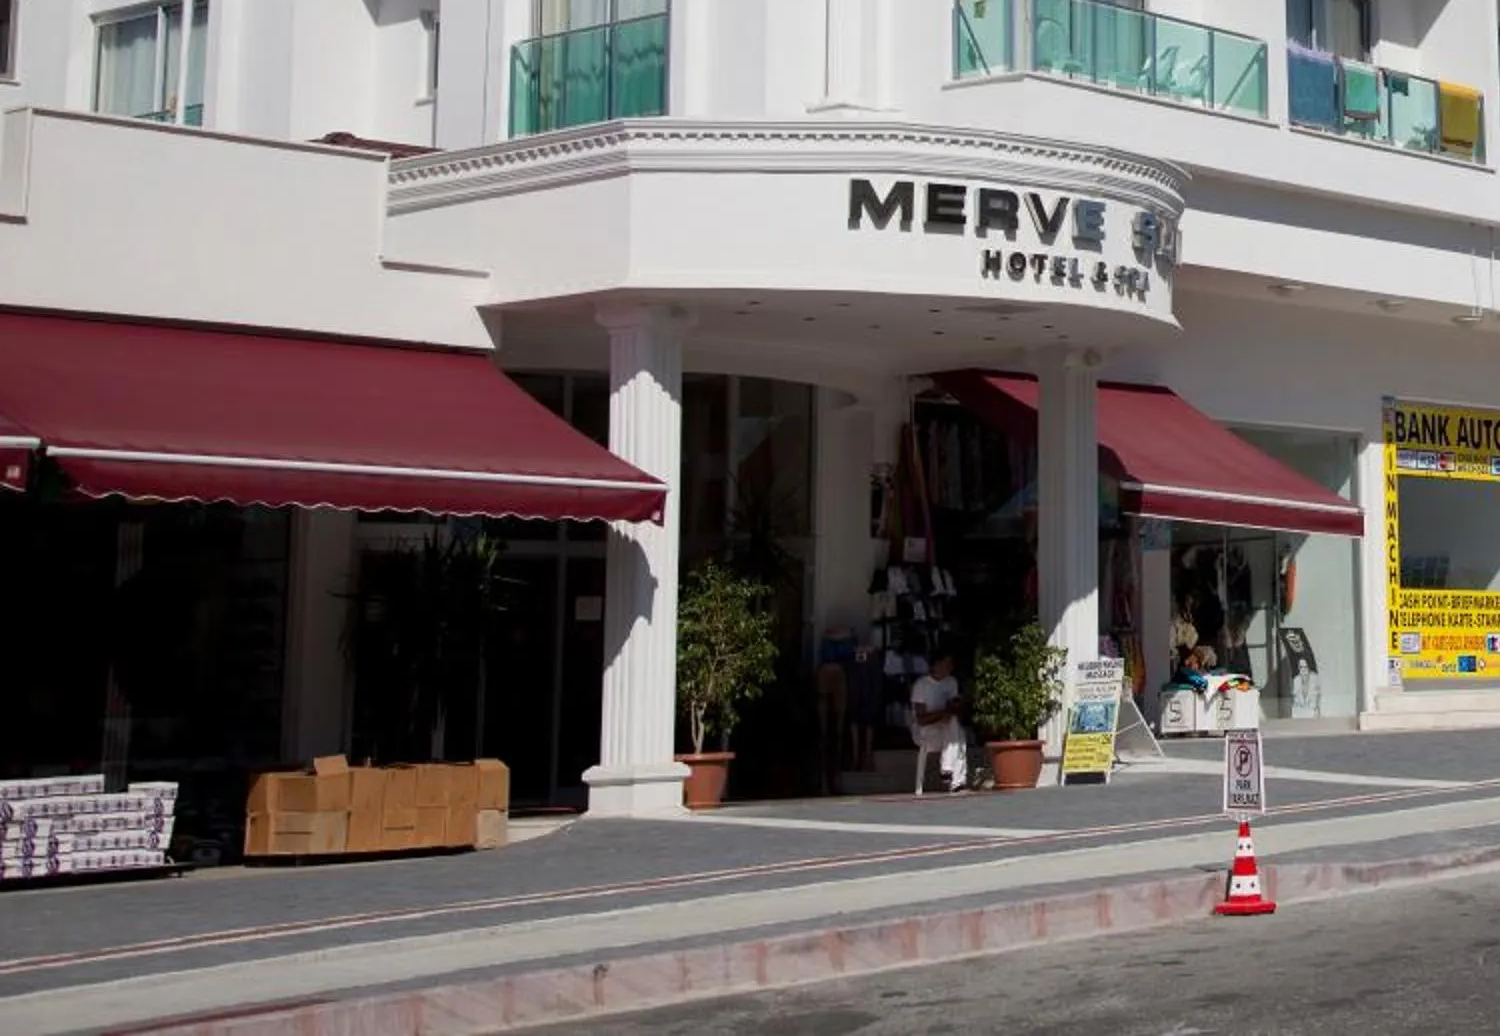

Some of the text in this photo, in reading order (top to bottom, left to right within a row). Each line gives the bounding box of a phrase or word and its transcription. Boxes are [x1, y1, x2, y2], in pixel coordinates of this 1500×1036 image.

[849, 179, 1106, 242] MERVE
[983, 250, 1084, 282] HOTEL
[1093, 261, 1108, 284] &
[1395, 412, 1450, 446] BANK
[1386, 501, 1398, 650] MACHINE
